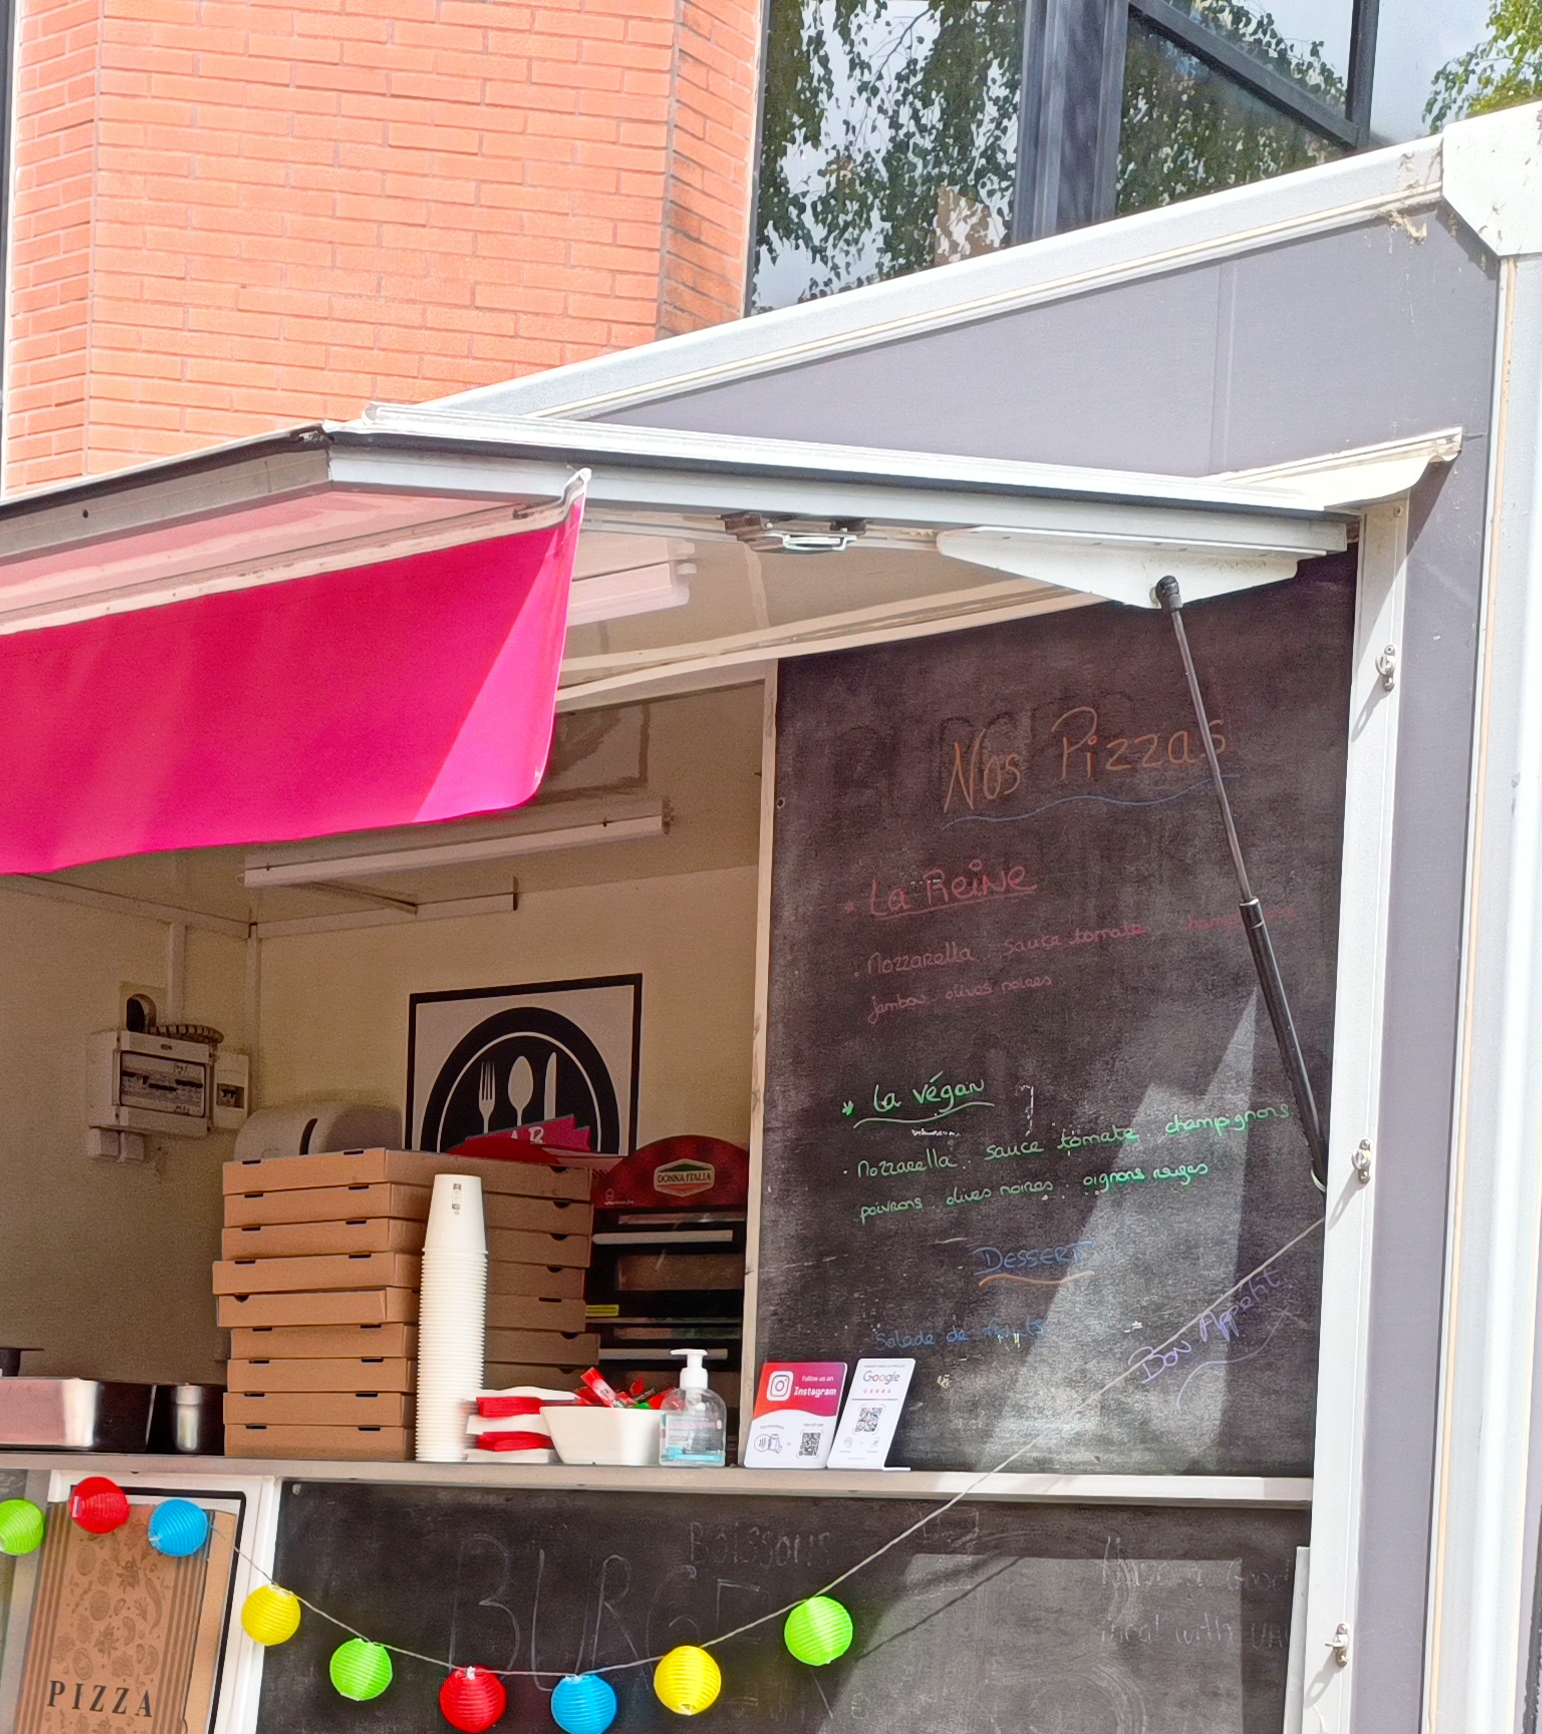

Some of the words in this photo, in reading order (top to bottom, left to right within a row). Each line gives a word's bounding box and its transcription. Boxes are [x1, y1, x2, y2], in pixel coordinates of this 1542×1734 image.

[943, 728, 1021, 813] Nos
[1051, 706, 1227, 780] Pizzas
[870, 879, 911, 917] La
[1057, 1125, 1140, 1150] tomate
[1164, 1103, 1290, 1138] champignons
[658, 1172, 685, 1184] DONNA
[685, 1172, 712, 1183] ITALIA
[860, 1197, 925, 1225] poivrons
[946, 1186, 992, 1206] olives
[999, 1181, 1054, 1196] noires
[1082, 1168, 1145, 1193] oignons
[794, 1386, 837, 1398] Instagram
[863, 1370, 900, 1385] Google
[47, 1680, 154, 1718] PIZZA
